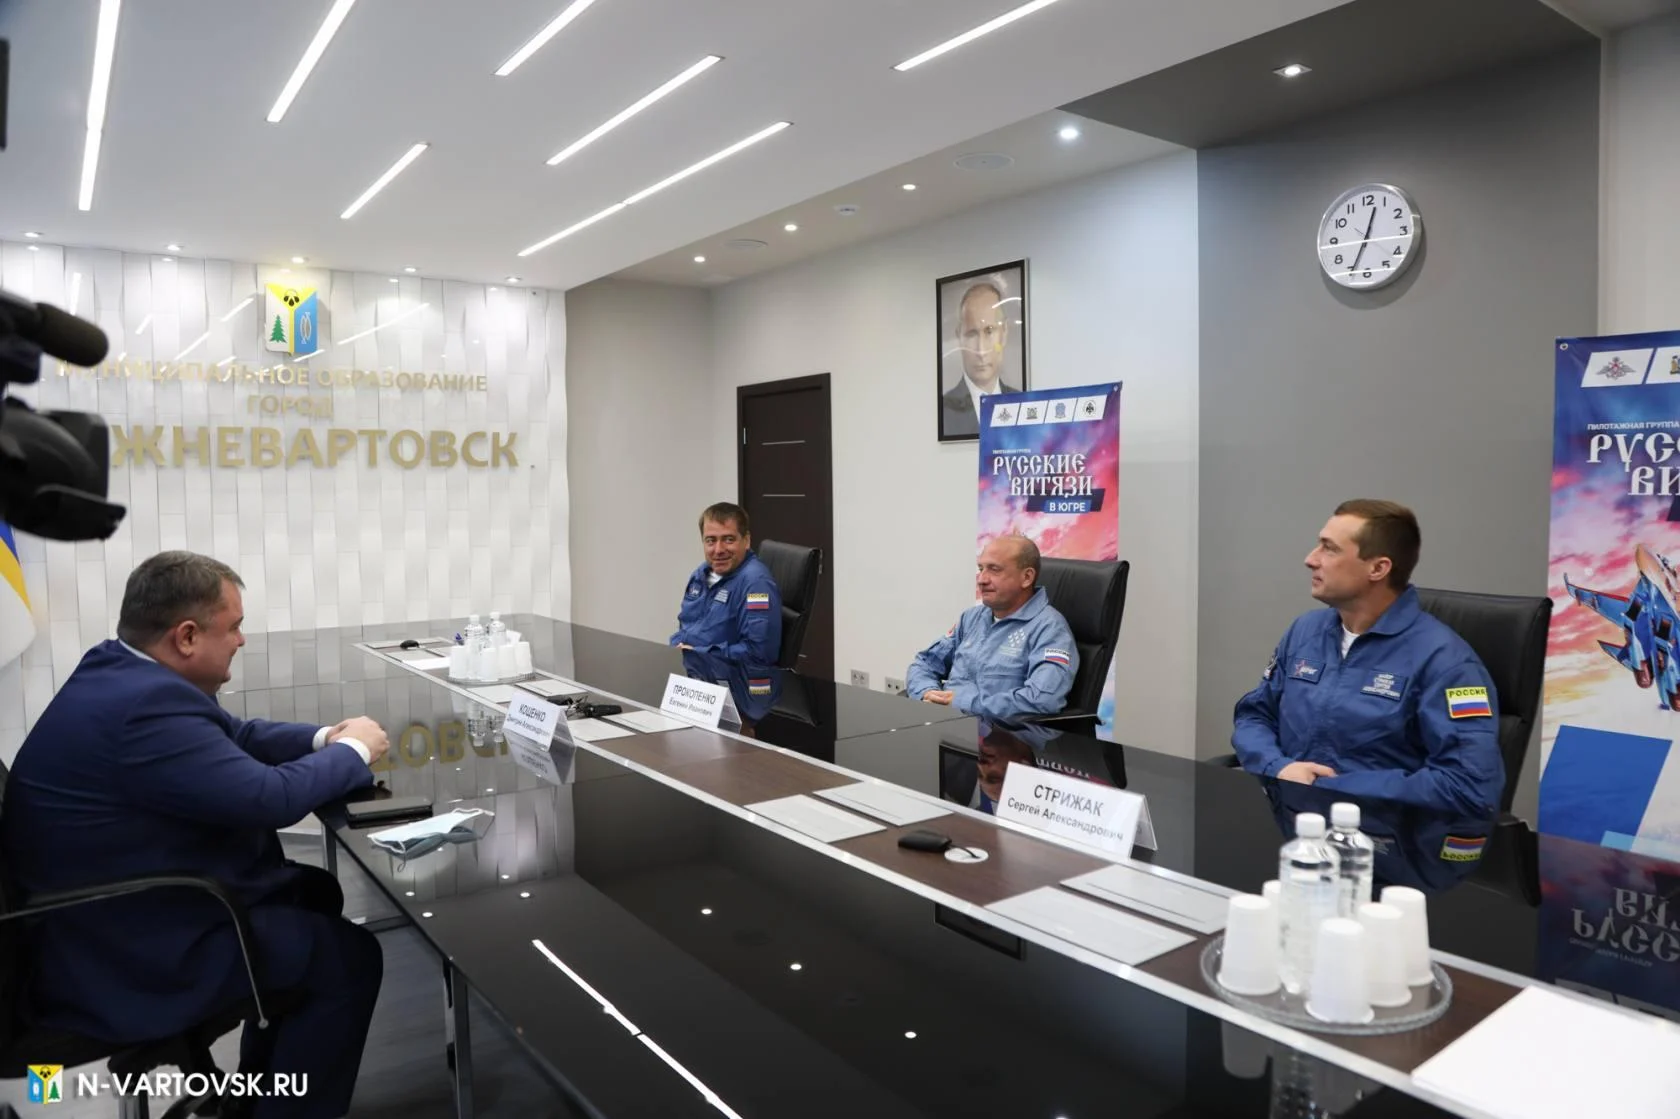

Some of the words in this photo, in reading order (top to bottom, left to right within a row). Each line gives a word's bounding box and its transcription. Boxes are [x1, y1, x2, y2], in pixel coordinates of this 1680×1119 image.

[1362, 194, 1375, 206] 12
[1383, 196, 1387, 207] 1
[1347, 204, 1355, 214] 11
[1393, 208, 1403, 219] 2
[1336, 217, 1347, 229] 10
[1400, 226, 1408, 236] 3
[1393, 245, 1402, 255] 4
[1334, 254, 1344, 265] 8
[1382, 260, 1391, 269] 5
[316, 368, 488, 392] ОБРАЗОВАНИЕ
[247, 394, 334, 419] ГОРОД
[111, 425, 519, 470] ЖНЕВАРТОВСК
[1586, 432, 1680, 473] РУС
[1010, 475, 1093, 498] ВИТЯЗИ
[1627, 465, 1680, 496] ВИ
[1049, 503, 1056, 513] В
[1058, 501, 1086, 512] ЮГРЕ
[672, 684, 717, 705] ПРОКОПЕНКО
[1449, 688, 1486, 699] РОССИЯ
[1033, 784, 1105, 817] СТРИЖАК
[1007, 796, 1041, 816] Сергей
[1041, 807, 1124, 842] Александрович
